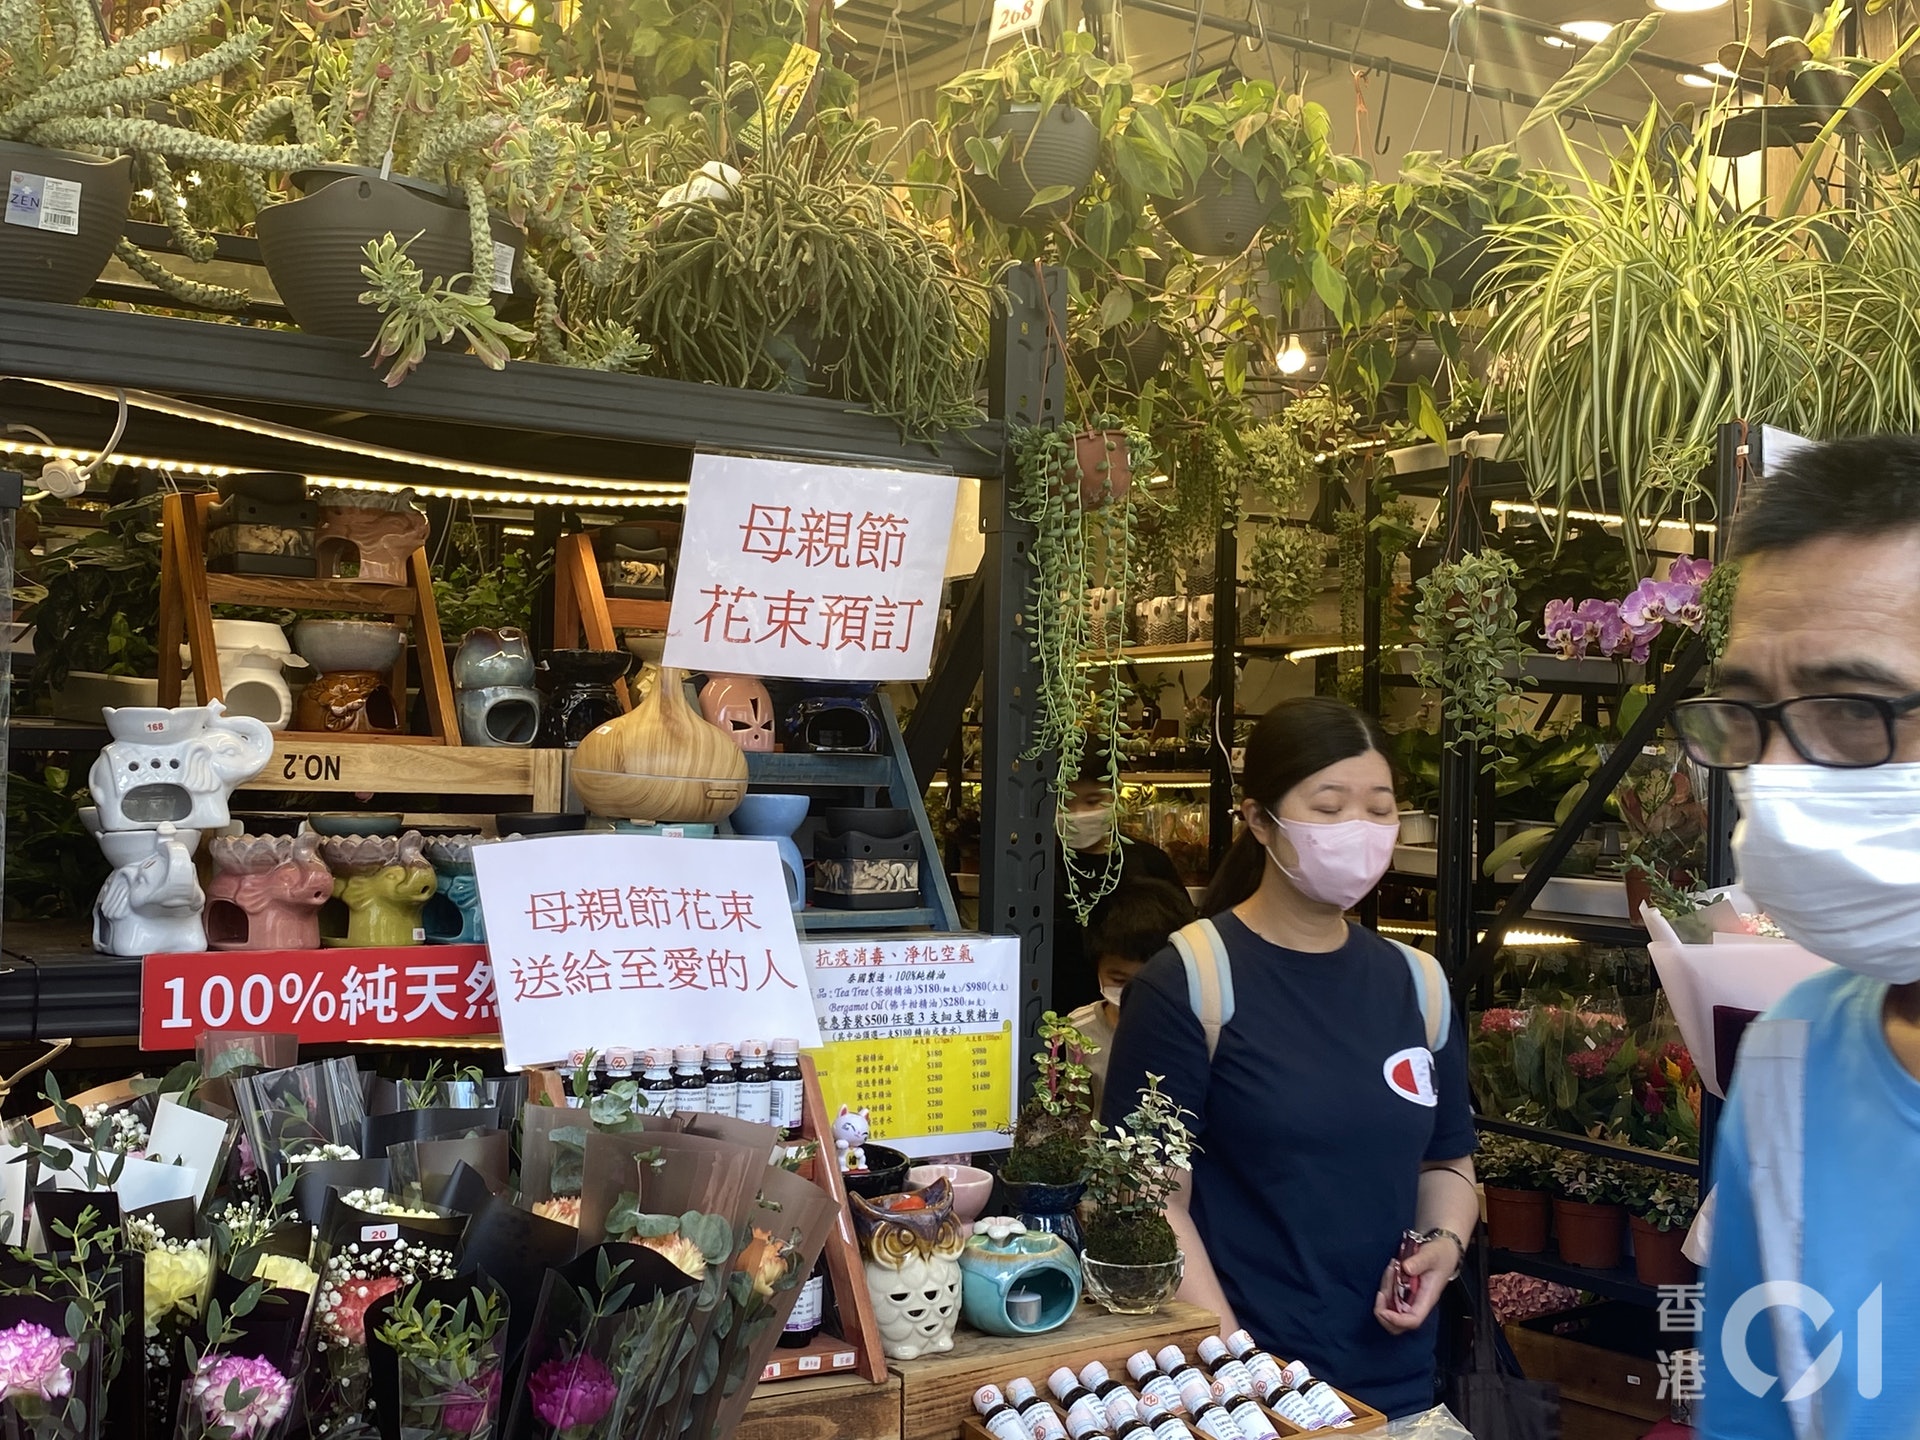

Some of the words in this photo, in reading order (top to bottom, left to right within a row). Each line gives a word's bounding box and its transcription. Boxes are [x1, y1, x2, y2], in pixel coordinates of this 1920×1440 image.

[10, 193, 40, 208] ZEN
[739, 503, 909, 572] 母親節
[694, 584, 924, 653] 花束預訂
[147, 722, 164, 731] 168
[283, 754, 341, 781] NO.2
[524, 885, 763, 934] 母親節花束
[816, 944, 975, 967] 抗疫消毒、淨化空氣
[509, 946, 799, 1003] 送給至愛的人
[828, 1002, 869, 1014] Bergamot
[371, 1230, 387, 1239] 20
